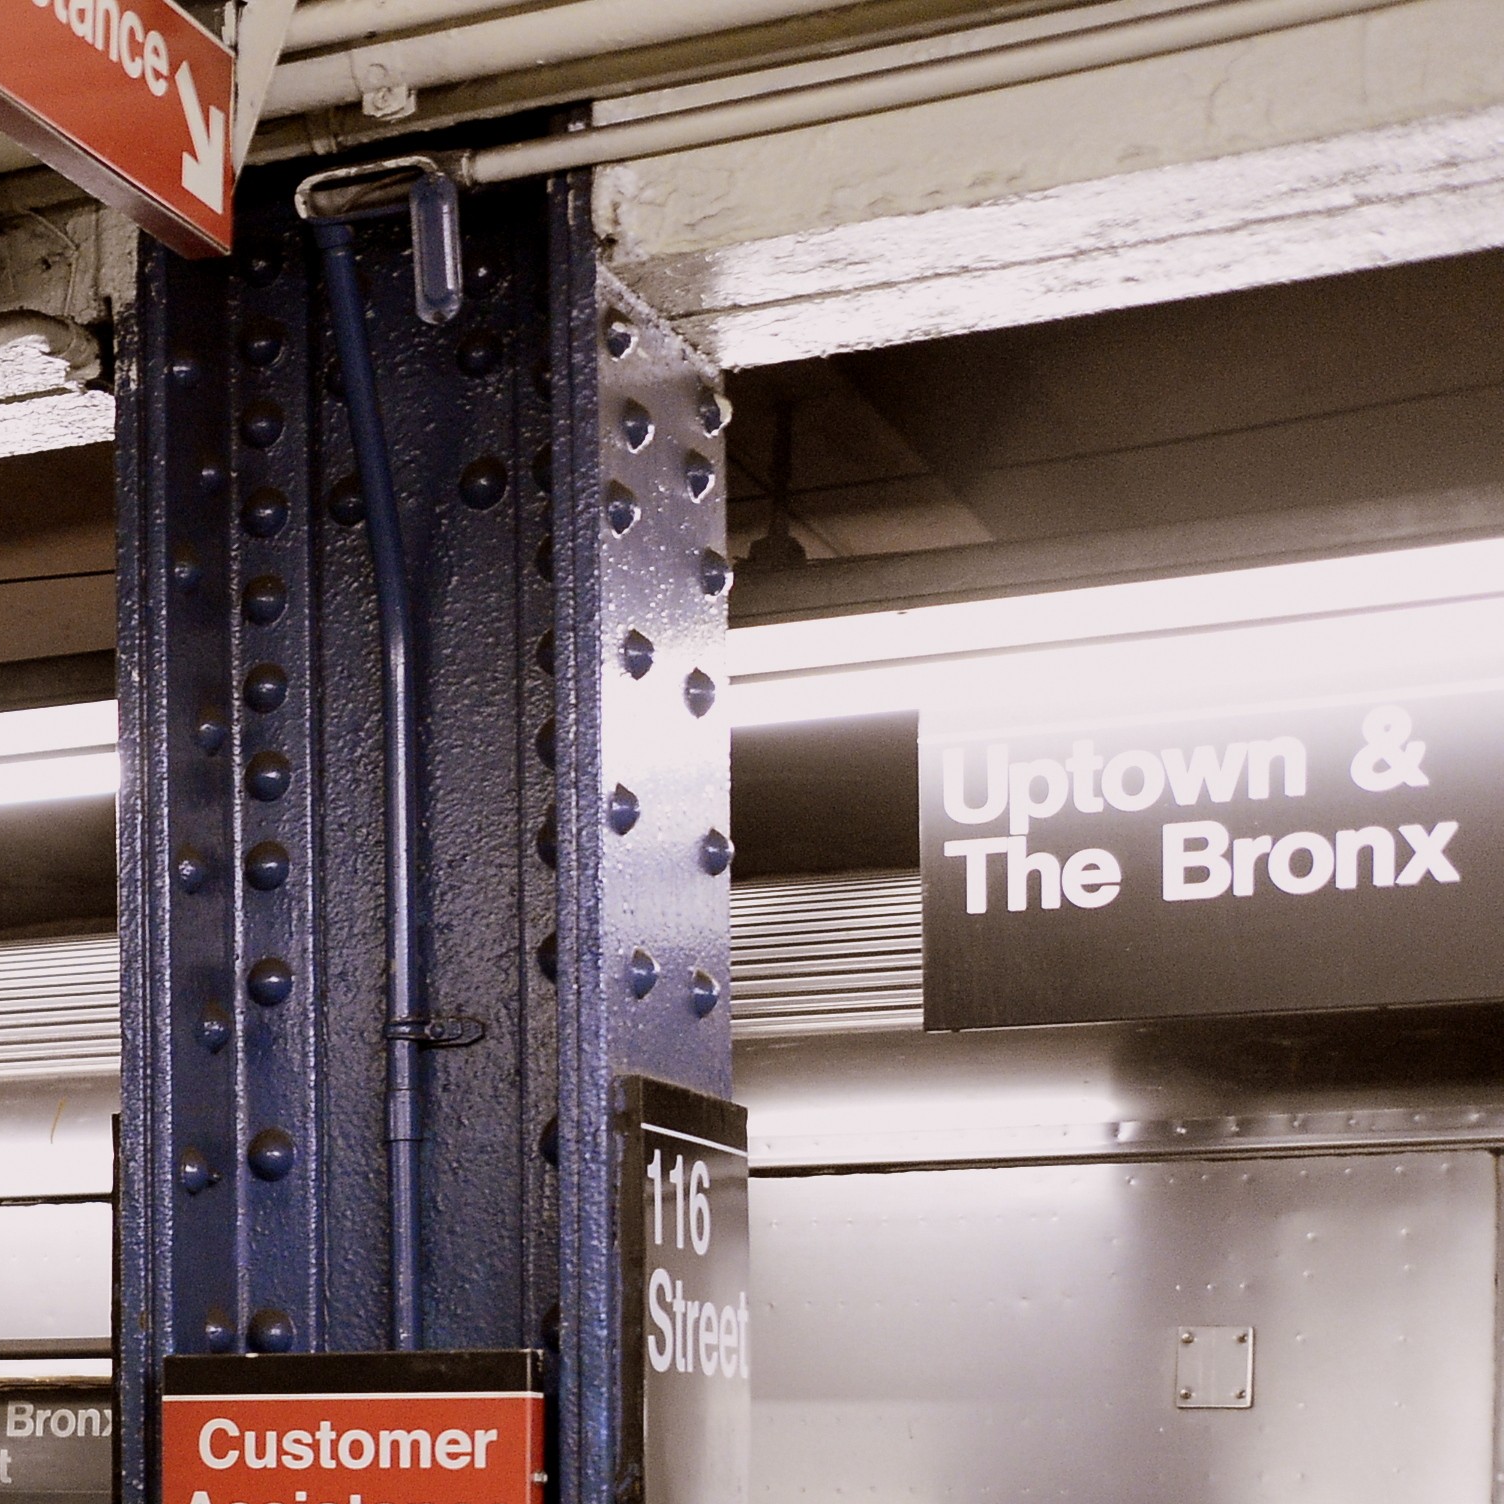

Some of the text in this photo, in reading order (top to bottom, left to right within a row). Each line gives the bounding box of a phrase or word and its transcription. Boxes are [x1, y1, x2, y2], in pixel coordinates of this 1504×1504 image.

[942, 704, 1430, 836] Uptown &
[943, 819, 1461, 915] The Bronx
[647, 1148, 712, 1256] 116
[647, 1268, 749, 1379] Street
[198, 1418, 498, 1469] Customer
